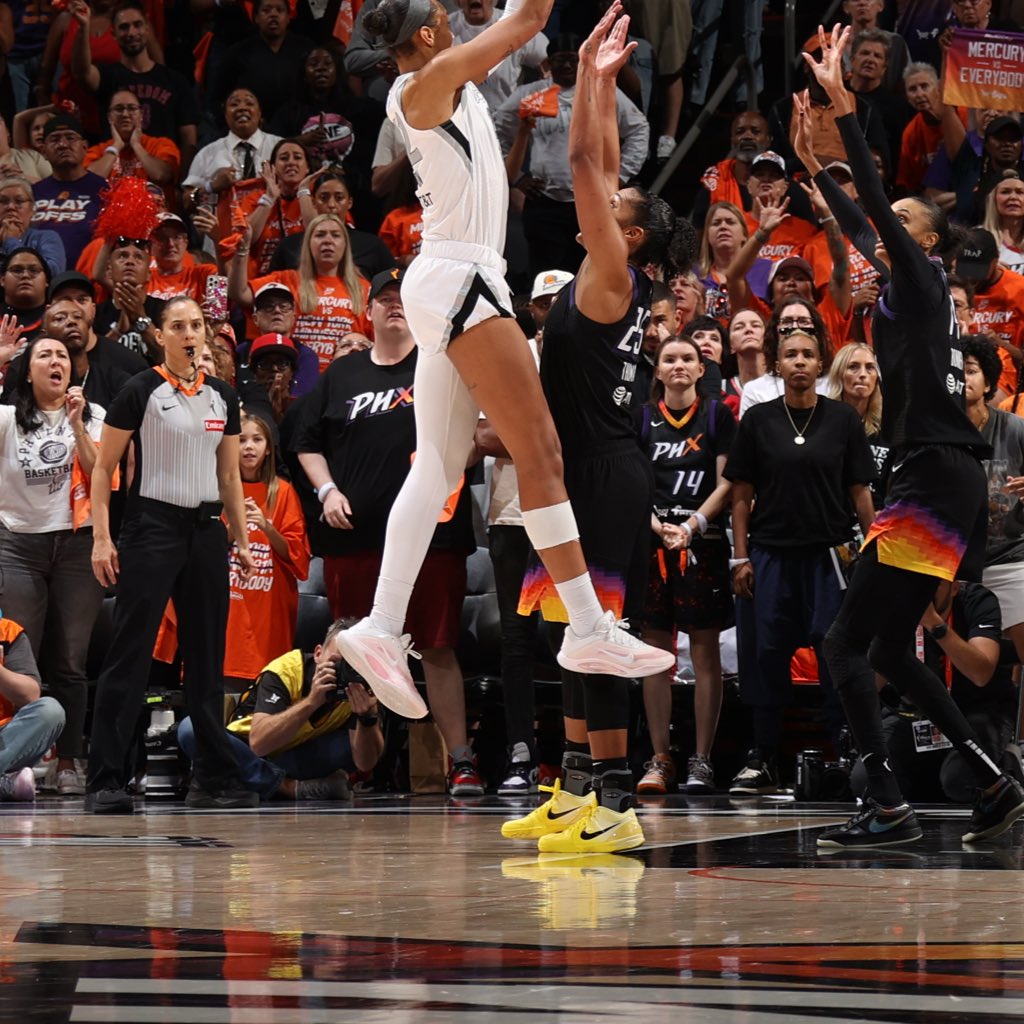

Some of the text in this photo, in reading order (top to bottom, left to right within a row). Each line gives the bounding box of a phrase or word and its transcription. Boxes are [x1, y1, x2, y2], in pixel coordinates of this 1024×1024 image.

[34, 199, 91, 212] PLAY
[31, 211, 87, 222] OFFS
[757, 244, 794, 256] RCURY
[963, 249, 982, 259] TRAP
[973, 311, 1014, 323] RCURY
[348, 385, 413, 422] PHX
[651, 434, 704, 461] PHX
[24, 463, 74, 479] BASKETBA
[672, 471, 705, 496] 14
